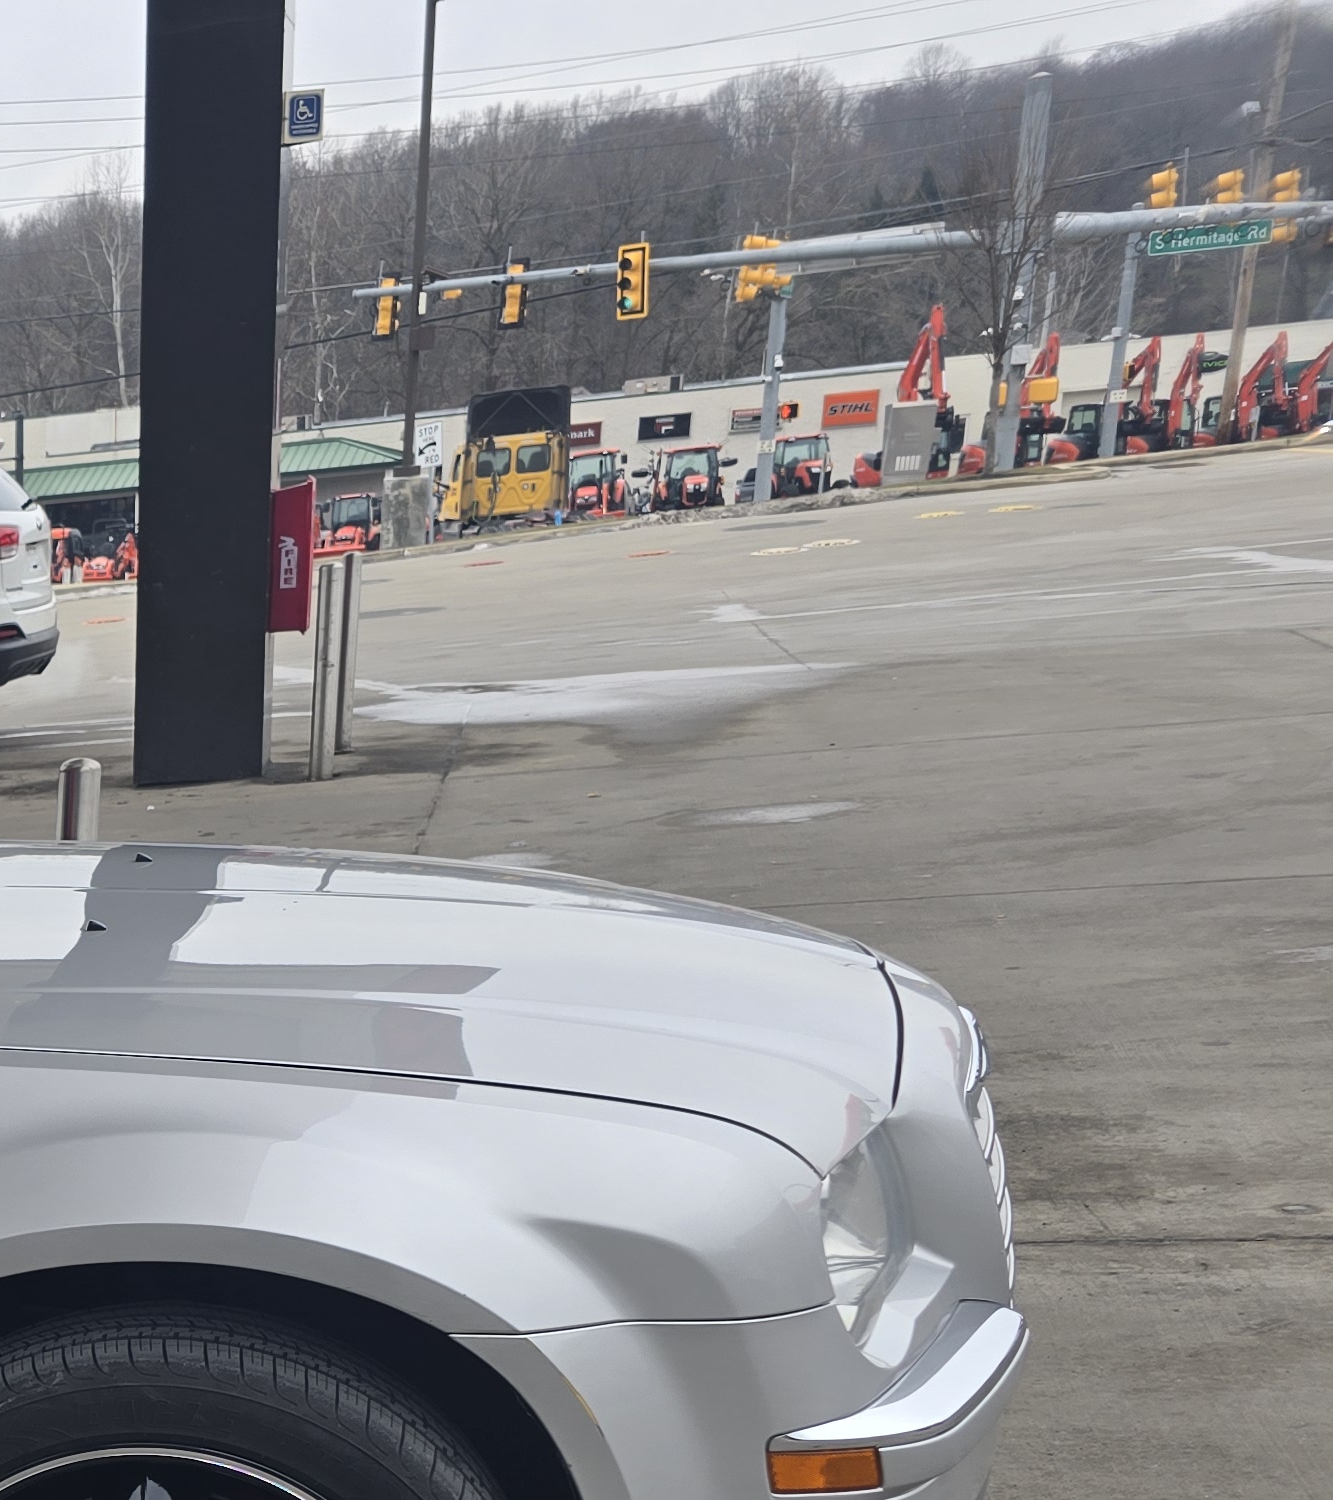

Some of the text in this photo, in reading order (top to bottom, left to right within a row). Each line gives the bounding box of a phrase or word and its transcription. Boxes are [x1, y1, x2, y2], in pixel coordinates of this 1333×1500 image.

[1155, 226, 1267, 249] S Hermitage Rd
[828, 402, 872, 416] STIHL
[418, 425, 439, 437] STOP
[425, 454, 440, 464] RED
[283, 549, 294, 585] FIRE
